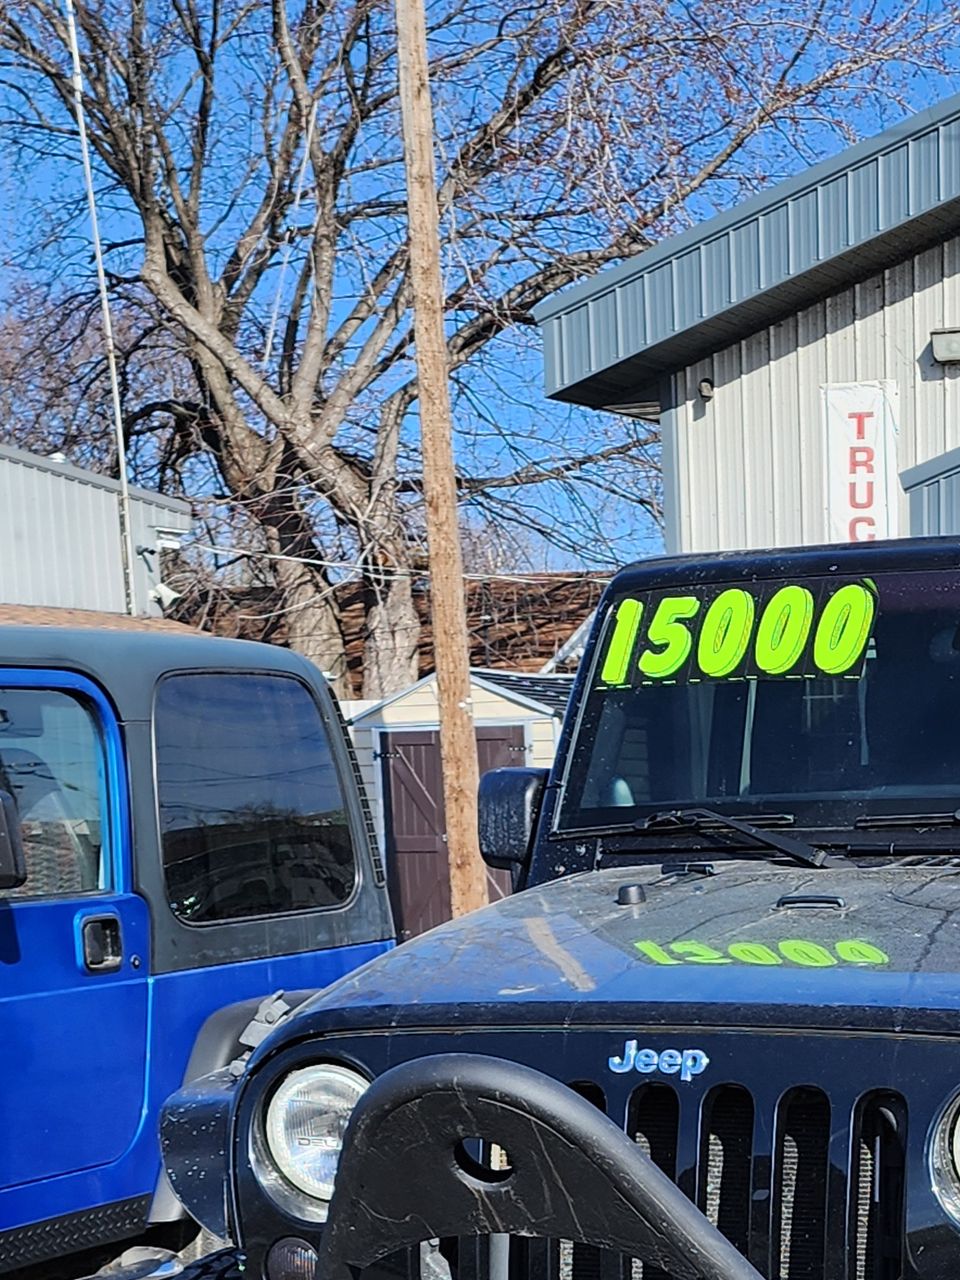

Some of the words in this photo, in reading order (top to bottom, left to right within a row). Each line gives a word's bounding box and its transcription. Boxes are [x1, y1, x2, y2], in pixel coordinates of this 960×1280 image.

[847, 411, 876, 543] TRUC
[601, 584, 875, 686] 15000
[608, 1039, 710, 1082] Jeep
